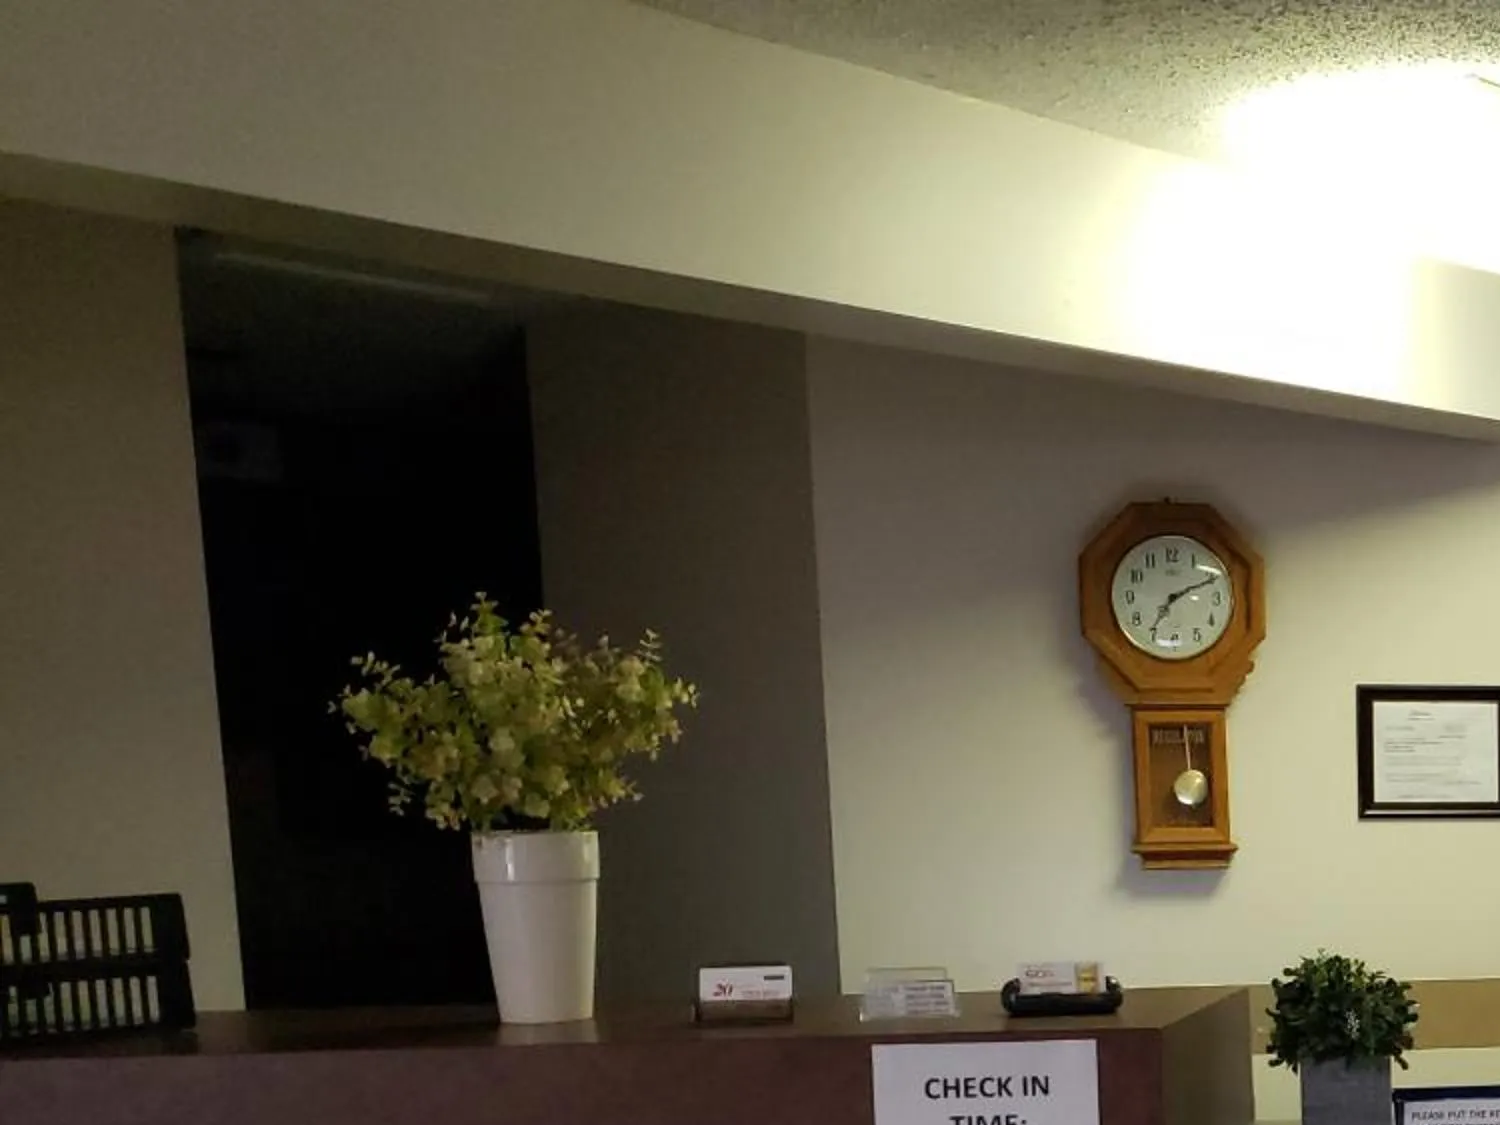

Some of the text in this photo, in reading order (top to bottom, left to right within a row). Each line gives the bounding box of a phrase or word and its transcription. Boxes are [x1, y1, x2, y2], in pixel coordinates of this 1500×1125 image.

[1145, 552, 1156, 569] 11
[1165, 547, 1179, 563] 12
[1131, 569, 1143, 584] 10
[924, 1075, 1050, 1101] CHECK IN
[1469, 1109, 1487, 1119] THE
